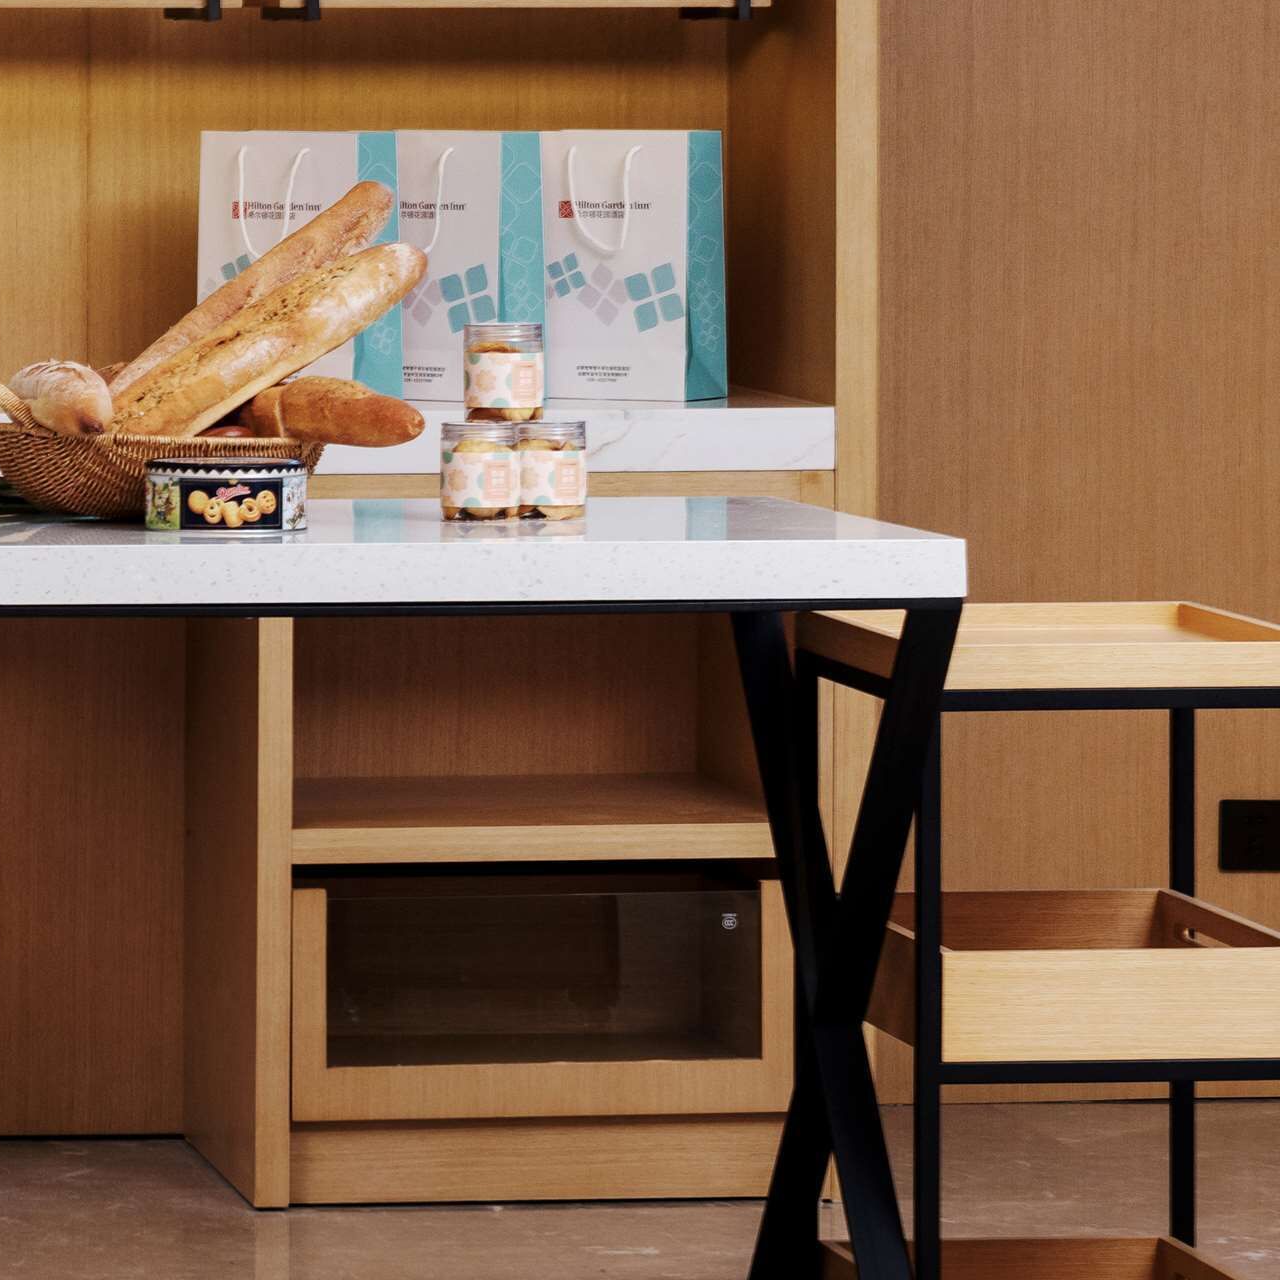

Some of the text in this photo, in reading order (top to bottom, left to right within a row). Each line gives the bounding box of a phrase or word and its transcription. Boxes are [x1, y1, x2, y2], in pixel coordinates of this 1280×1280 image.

[247, 200, 272, 210] Hilton
[305, 202, 321, 212] Inn
[450, 202, 465, 212] Inn
[575, 200, 601, 210] Hilton
[634, 201, 649, 211] Inn
